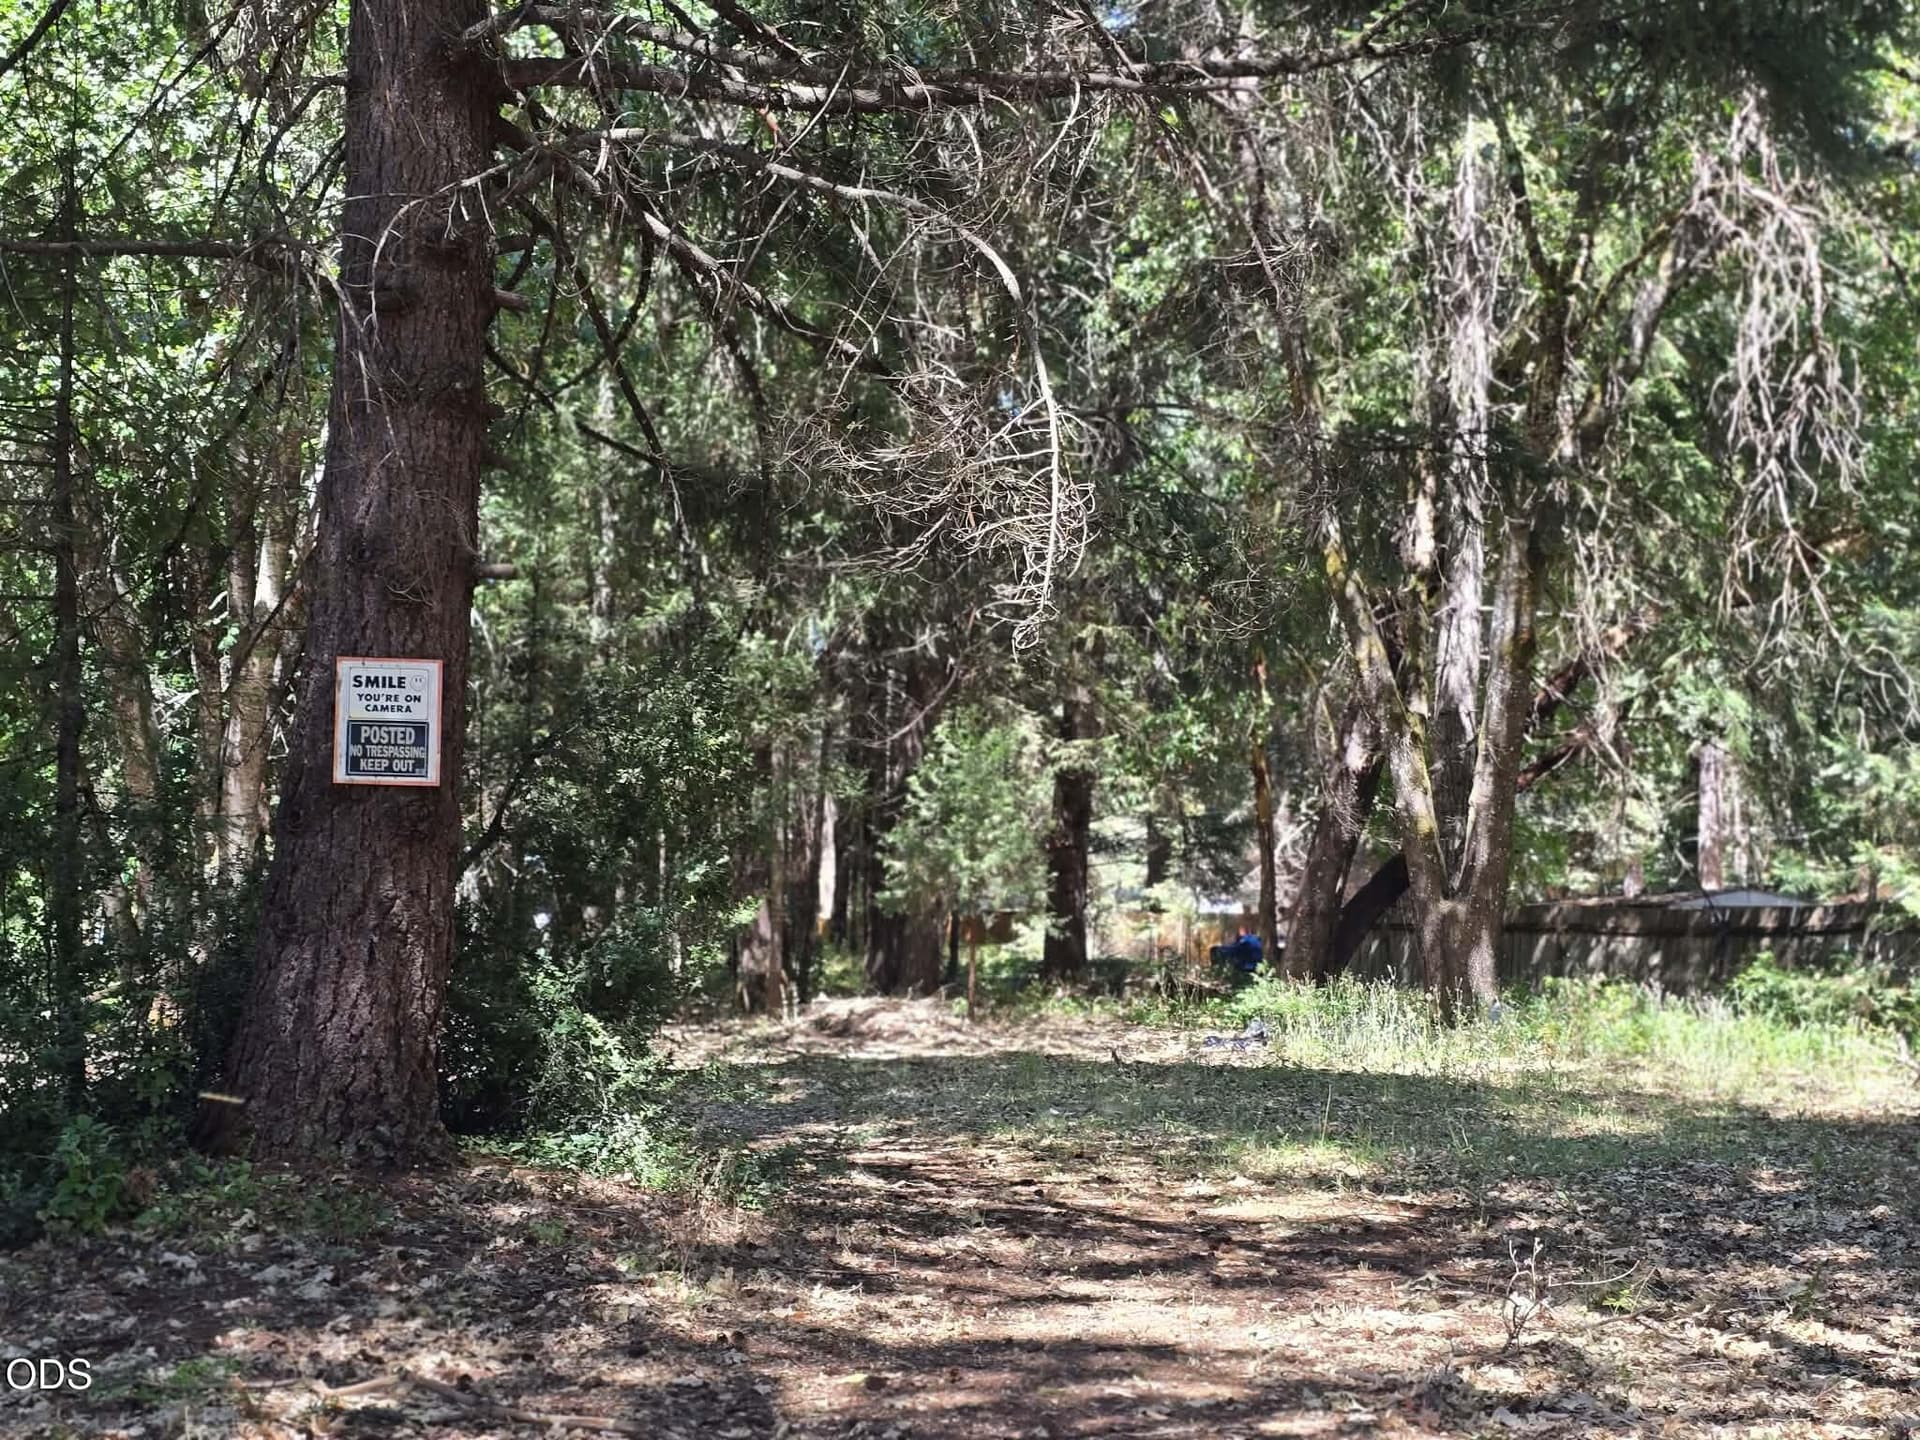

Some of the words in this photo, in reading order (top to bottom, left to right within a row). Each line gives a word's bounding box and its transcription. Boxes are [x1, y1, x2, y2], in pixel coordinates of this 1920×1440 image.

[352, 675, 406, 689] SMILE
[357, 693, 400, 703] YOU'RE
[404, 694, 422, 703] ON
[364, 704, 412, 713] CAMERA
[360, 725, 415, 745] POSTED
[350, 744, 363, 757] NO
[365, 745, 425, 758] TRESPASSING
[360, 758, 389, 771] KEEP
[392, 759, 415, 772] OUT
